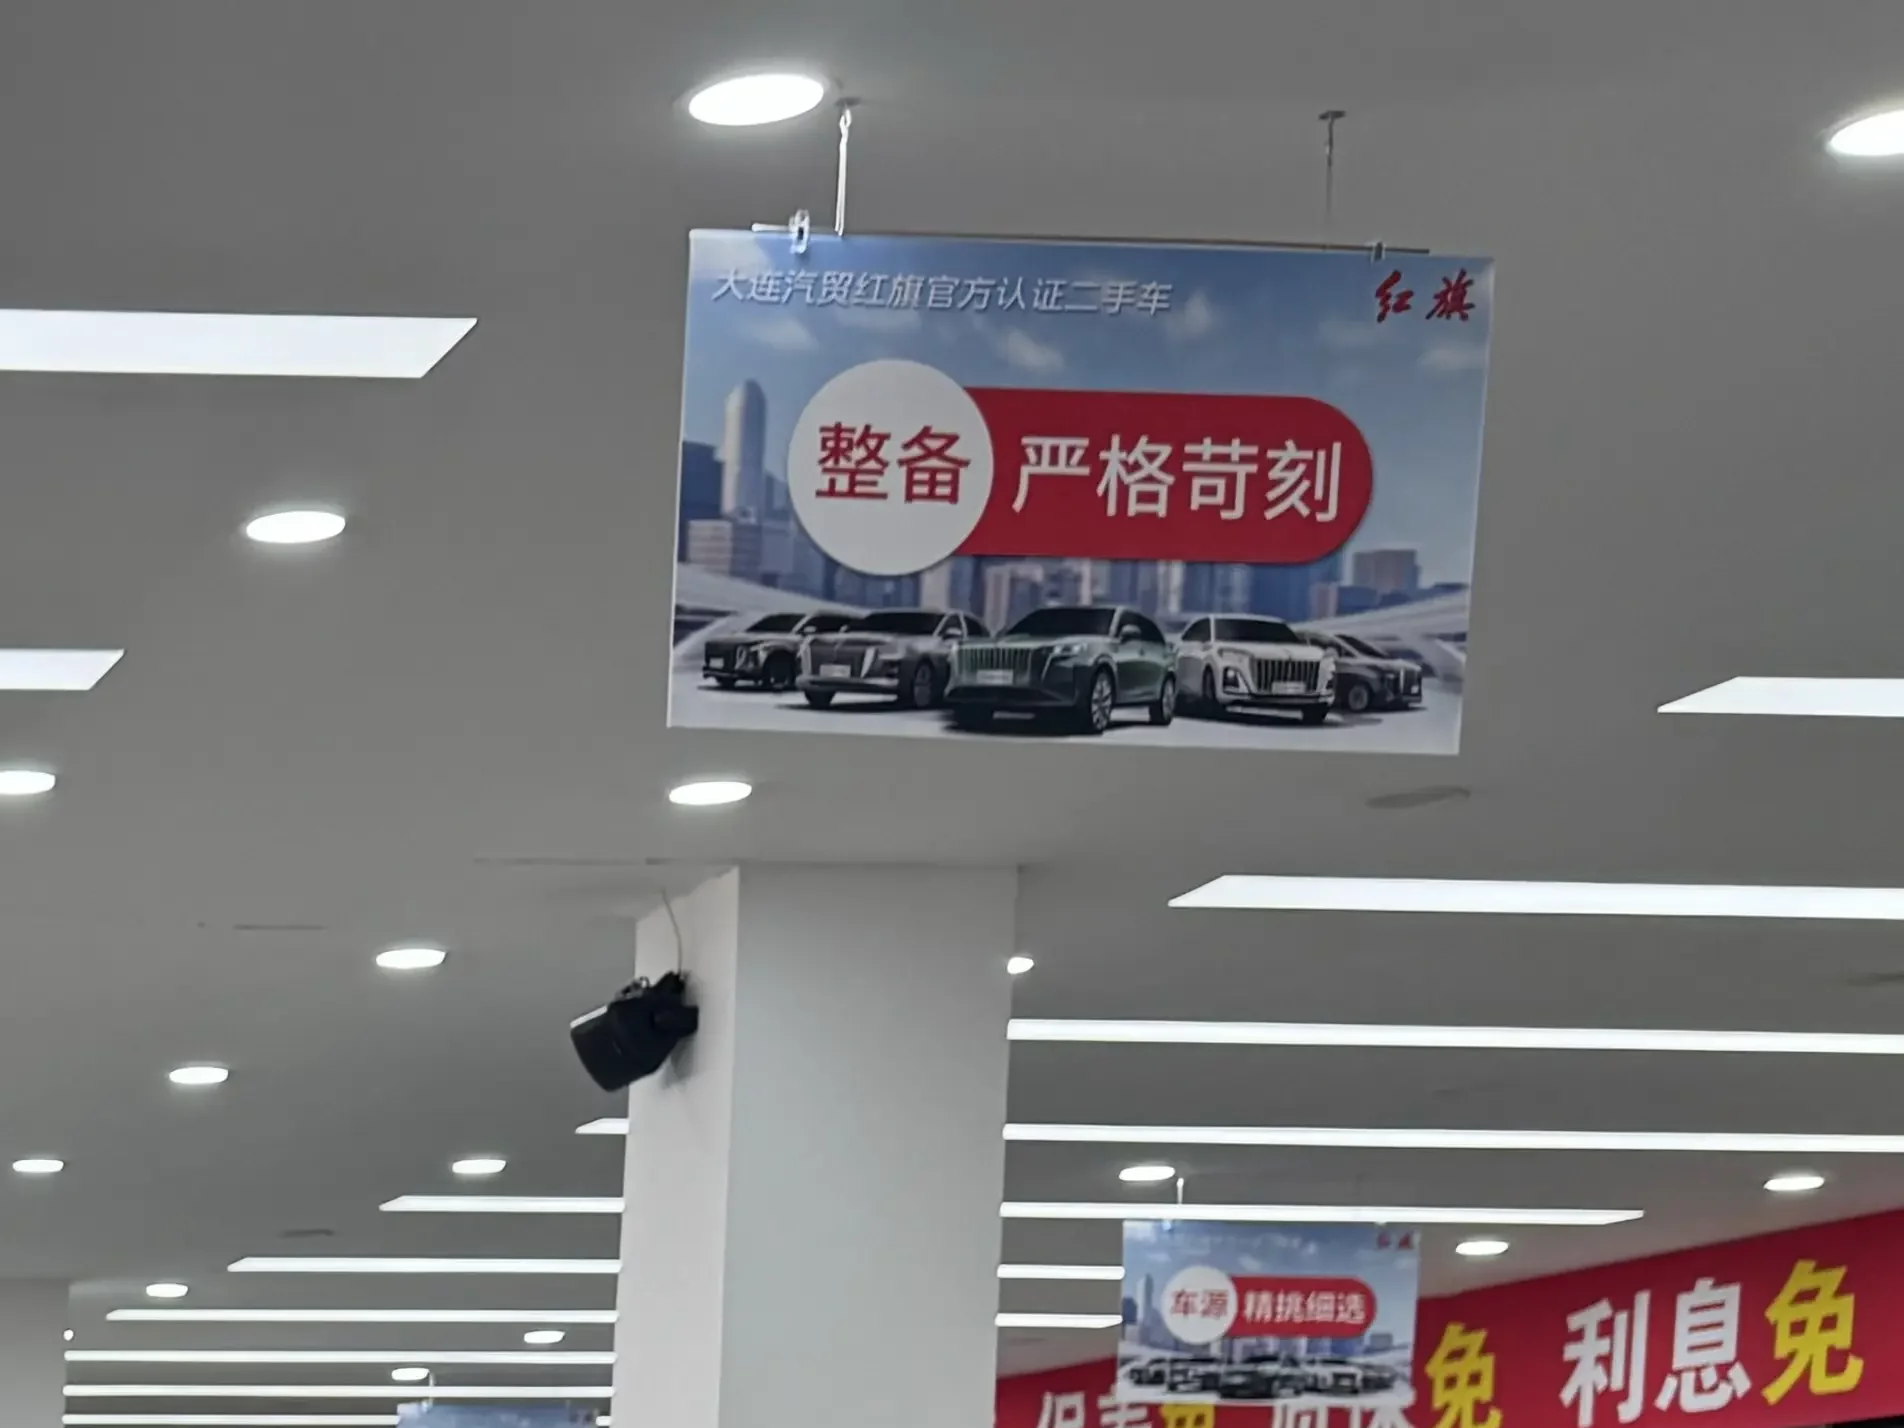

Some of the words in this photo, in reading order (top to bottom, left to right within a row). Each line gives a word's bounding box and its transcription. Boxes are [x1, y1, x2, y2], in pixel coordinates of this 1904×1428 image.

[711, 268, 1173, 315] 大连汽贸红旗官方认证二手车
[1375, 268, 1476, 323] 红旗
[815, 421, 971, 505] 整备
[1012, 434, 1343, 523] 严格苛刻
[1244, 1289, 1367, 1325] 精挑细选
